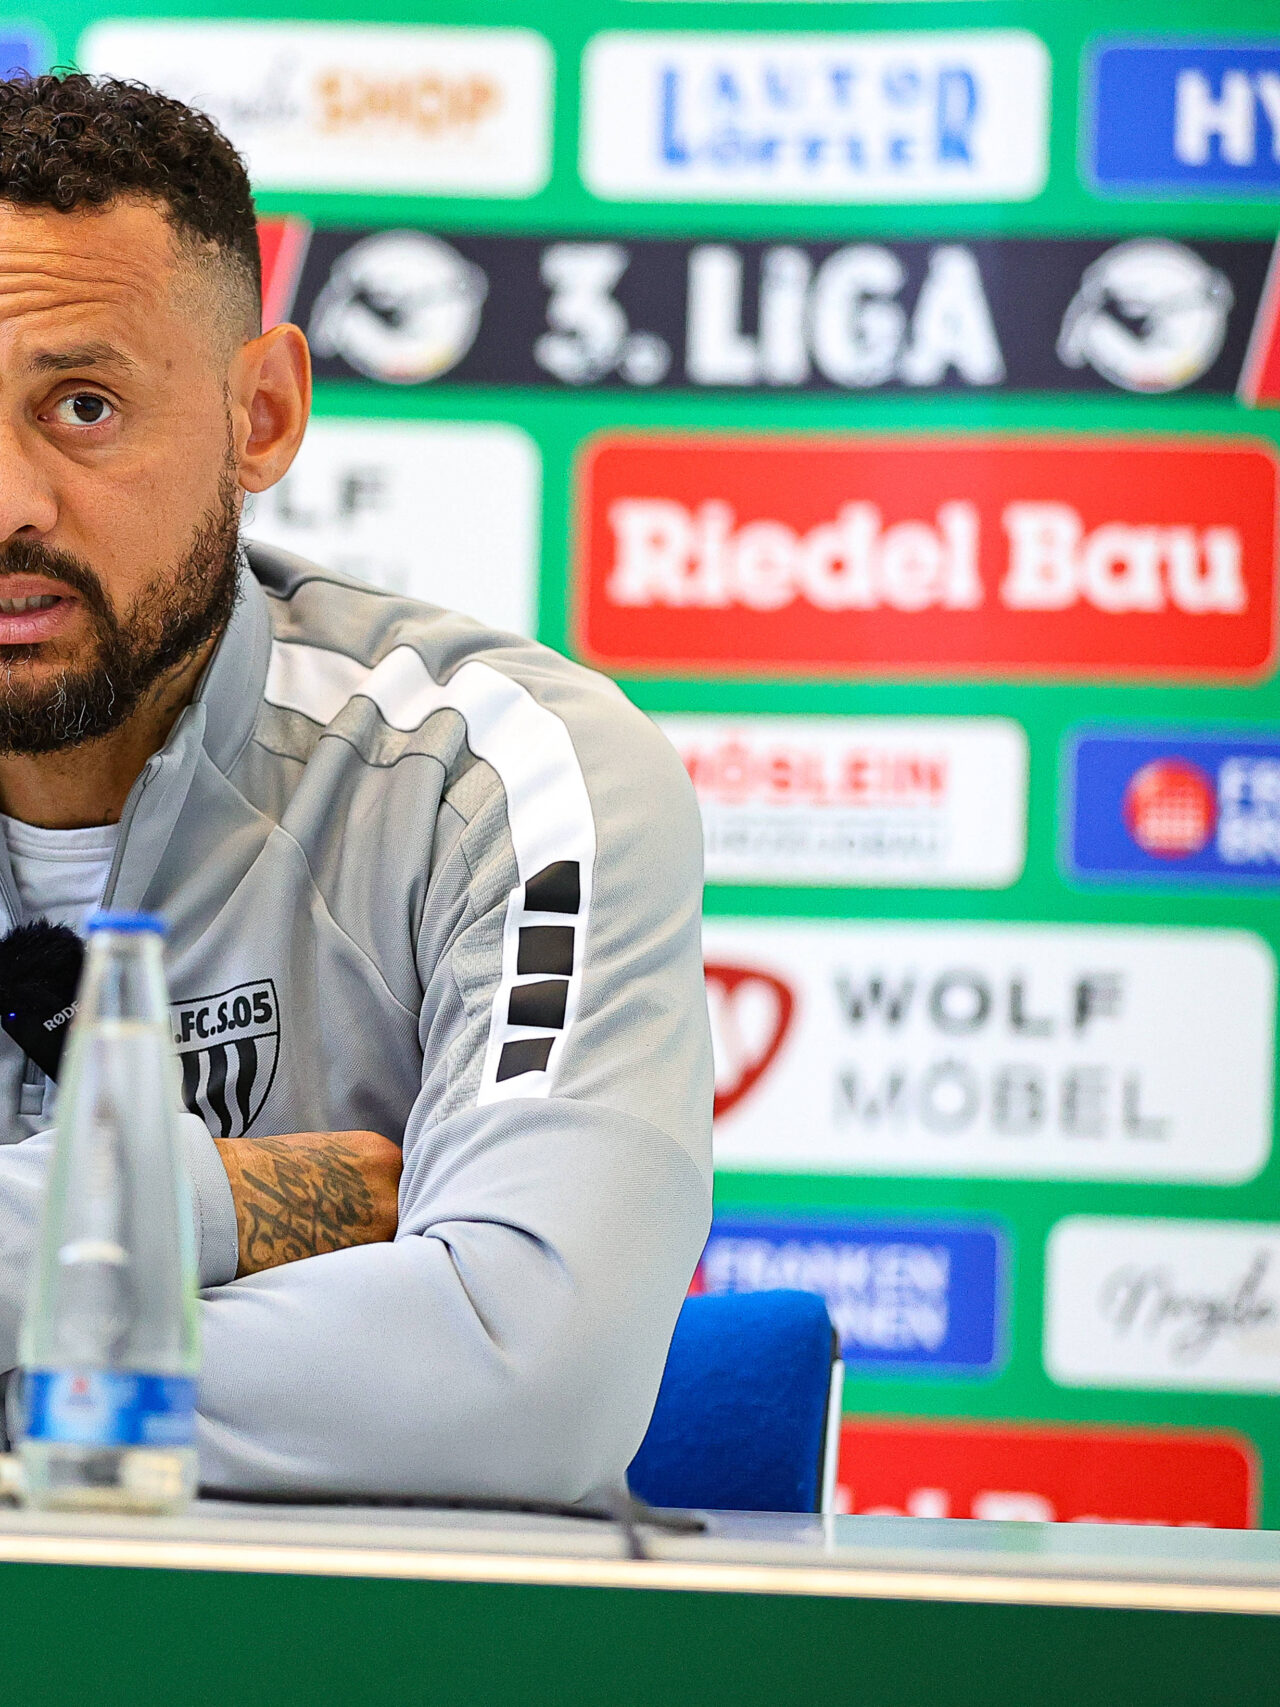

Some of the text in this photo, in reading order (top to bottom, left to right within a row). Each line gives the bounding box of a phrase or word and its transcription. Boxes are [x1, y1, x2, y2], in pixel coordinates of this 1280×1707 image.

[533, 242, 672, 386] 3.
[607, 497, 1248, 615] Riedel Bau
[174, 990, 273, 1044] .FC.S.05
[831, 965, 1126, 1038] WOLF
[830, 1050, 1175, 1142] MÖBEL
